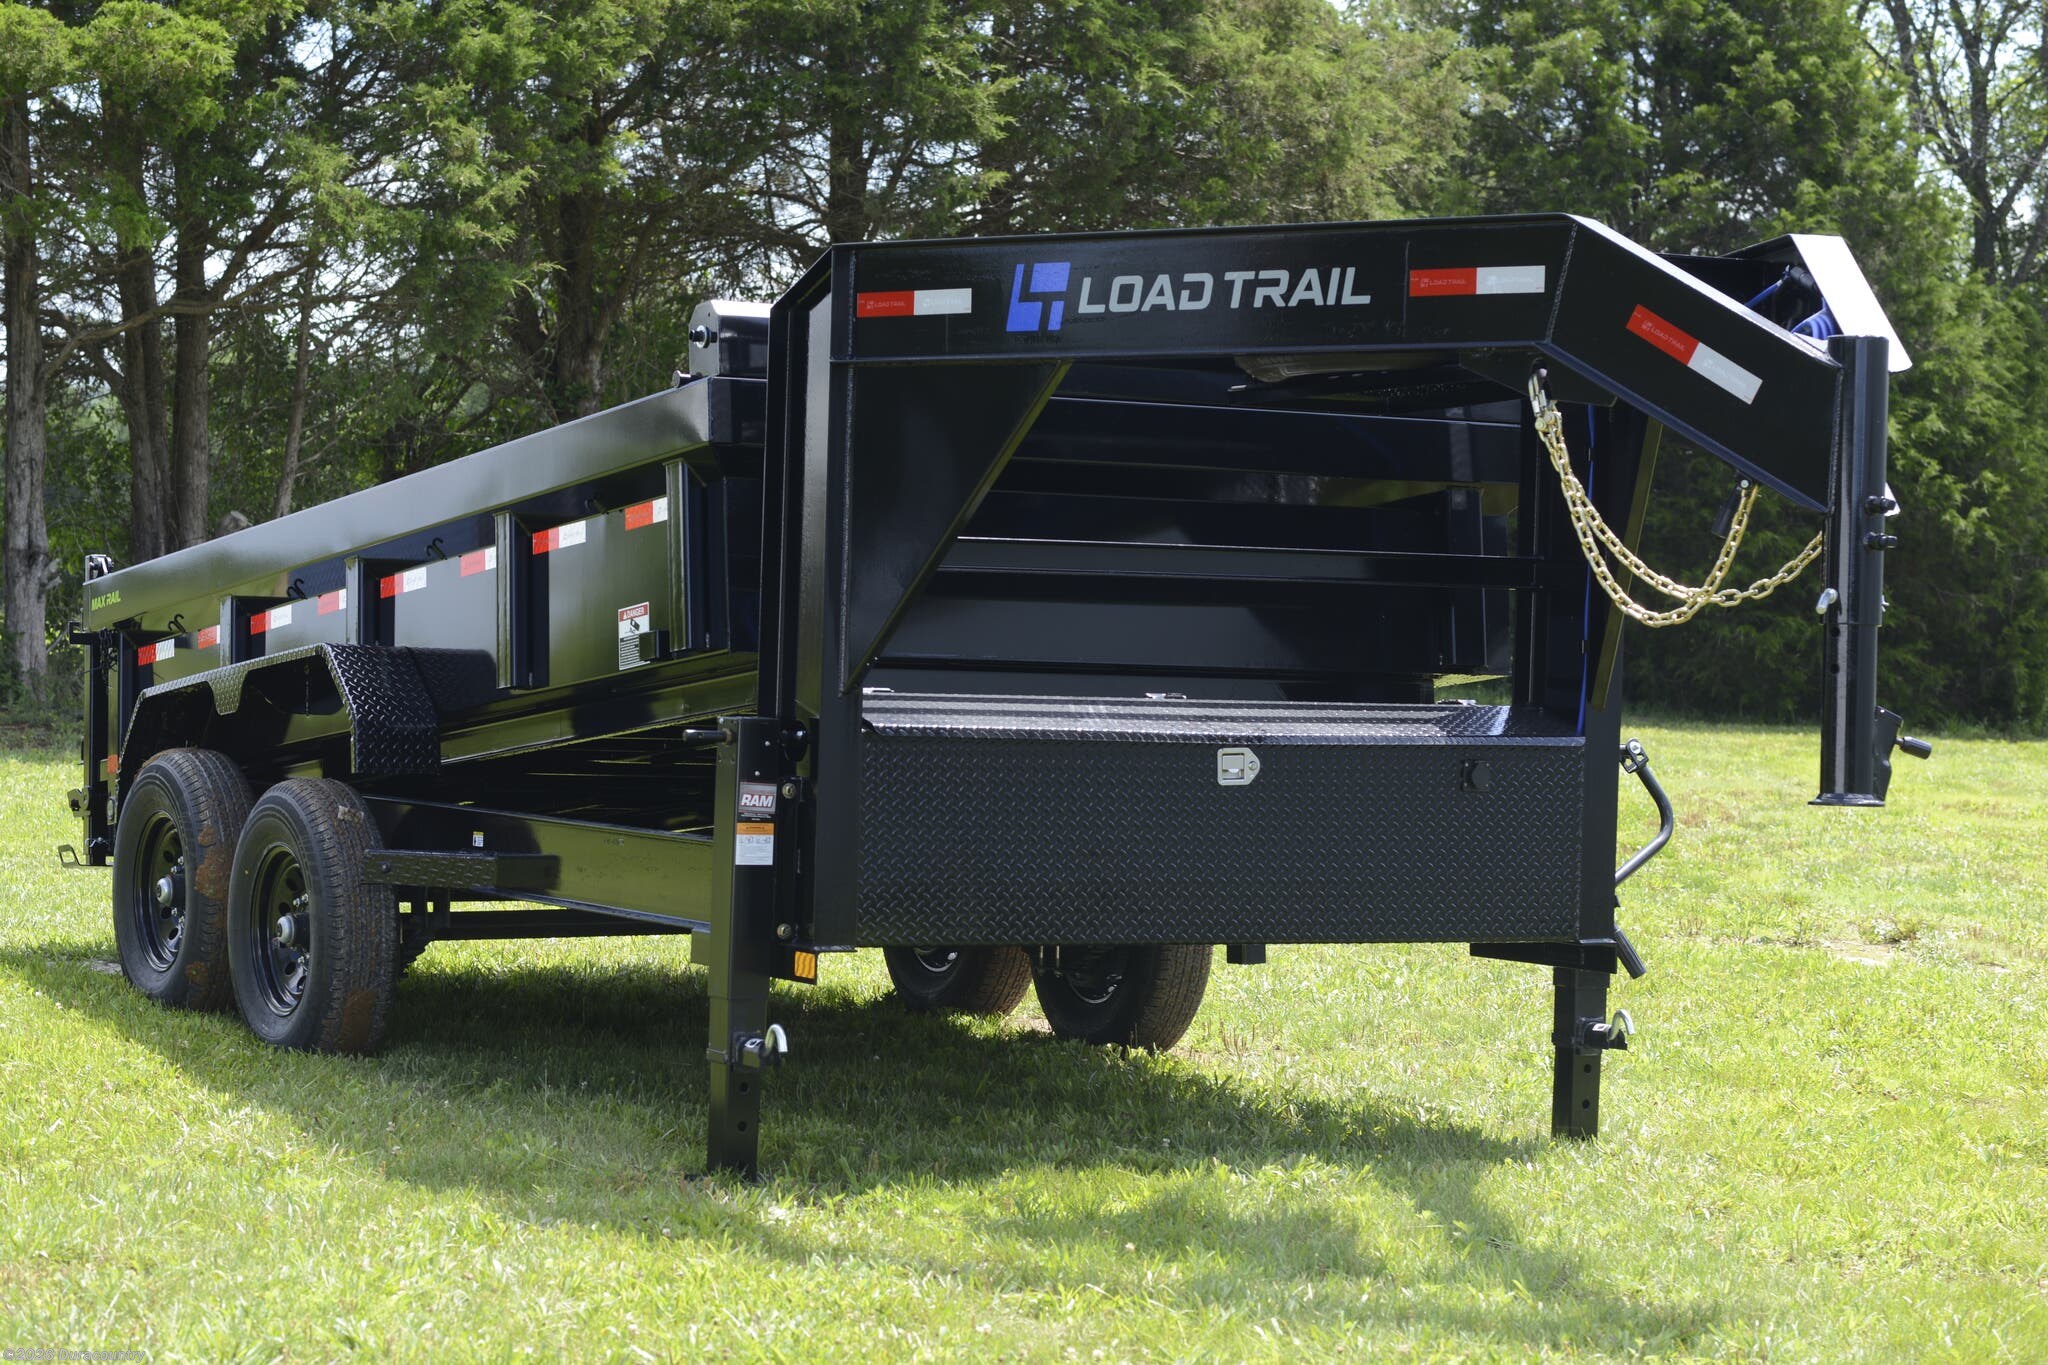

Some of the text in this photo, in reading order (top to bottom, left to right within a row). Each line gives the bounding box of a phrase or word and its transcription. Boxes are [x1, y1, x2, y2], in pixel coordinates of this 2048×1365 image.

[1078, 267, 1371, 314] LOAD TRAIL
[91, 590, 121, 611] MAX RAIL
[627, 606, 645, 617] DANGER
[741, 794, 773, 808] RAM
